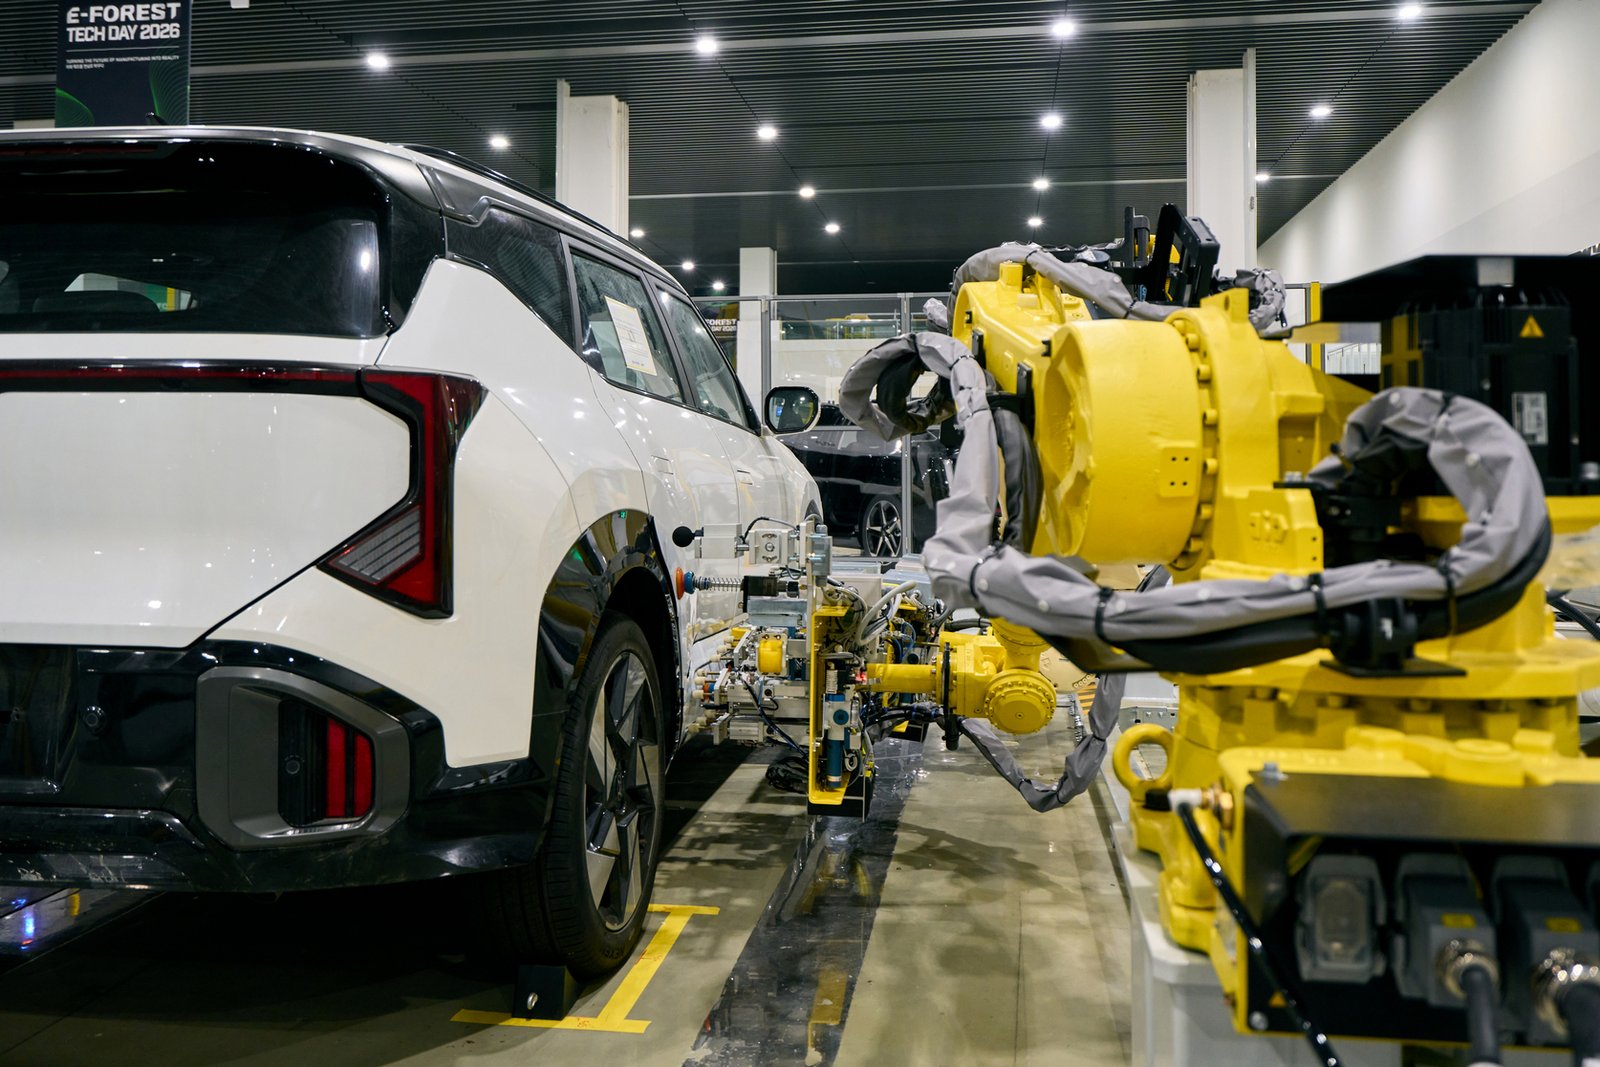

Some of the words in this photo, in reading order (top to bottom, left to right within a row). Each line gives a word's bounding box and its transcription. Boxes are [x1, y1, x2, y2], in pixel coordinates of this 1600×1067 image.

[66, 2, 181, 24] E-FOREST
[66, 26, 106, 42] TECH
[108, 24, 138, 41] DAY
[140, 22, 180, 40] 2026
